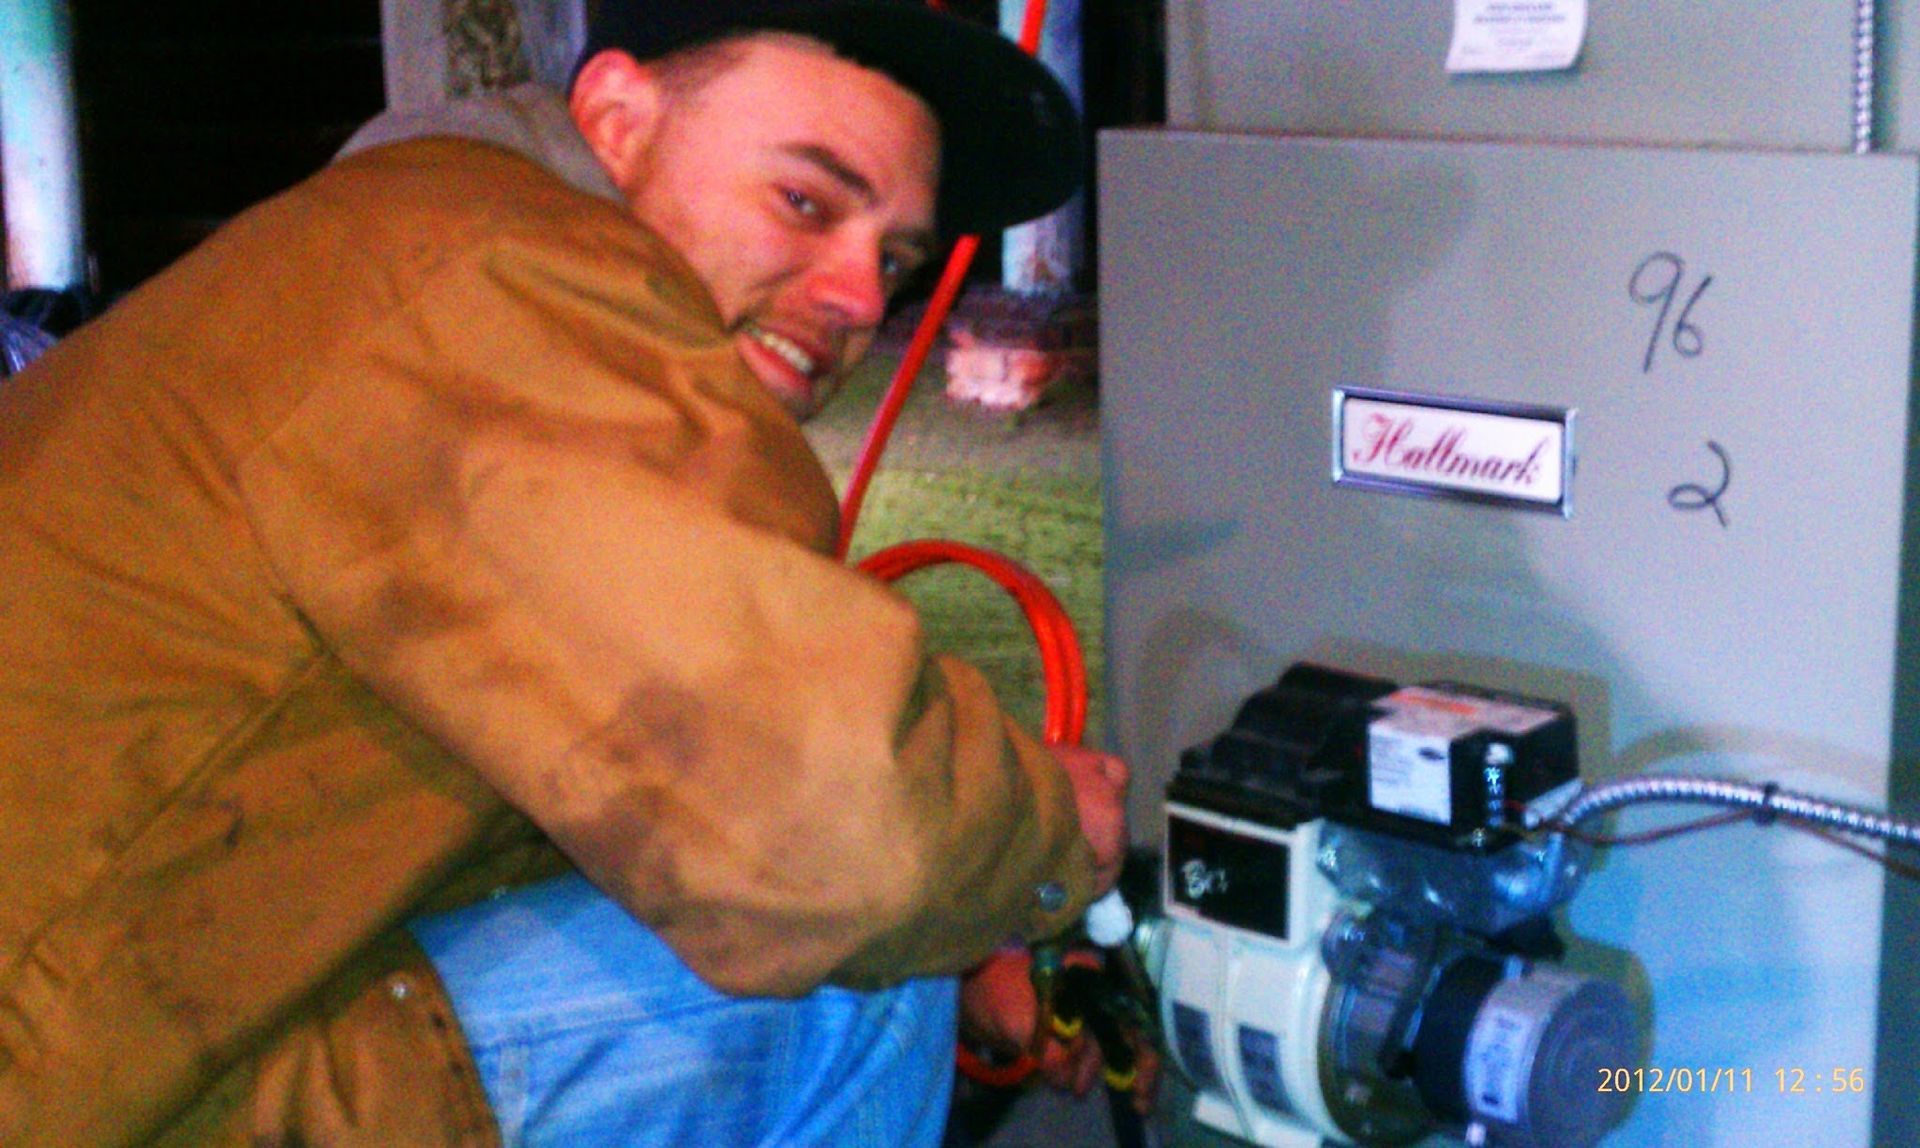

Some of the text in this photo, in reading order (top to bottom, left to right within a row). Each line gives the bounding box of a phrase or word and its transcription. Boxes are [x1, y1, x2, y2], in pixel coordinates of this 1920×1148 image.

[1628, 251, 1714, 374] 96
[1352, 412, 1552, 485] Hallmark
[1666, 439, 1731, 528] 2
